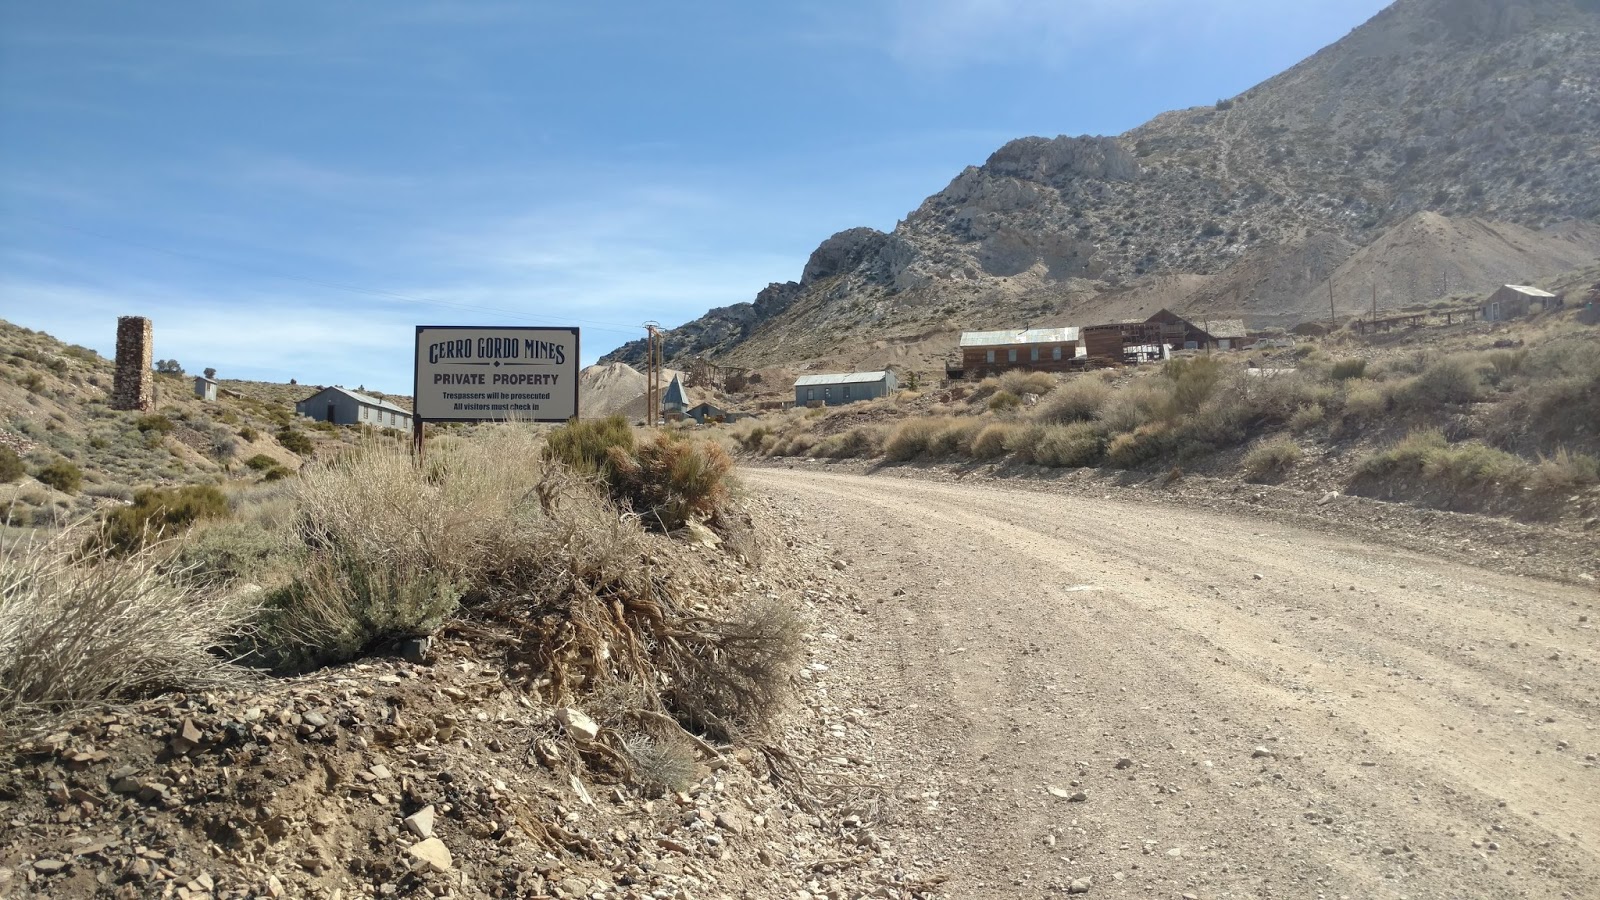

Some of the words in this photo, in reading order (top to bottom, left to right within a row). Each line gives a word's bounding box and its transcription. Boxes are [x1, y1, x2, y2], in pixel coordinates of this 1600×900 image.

[429, 338, 472, 364] CERRO
[478, 337, 519, 358] GORDO
[524, 339, 565, 364] MINES
[434, 374, 486, 384] PRIVATE
[493, 374, 559, 385] PROPERTY
[443, 392, 486, 400] Trespassers
[510, 392, 550, 400] prosecuted
